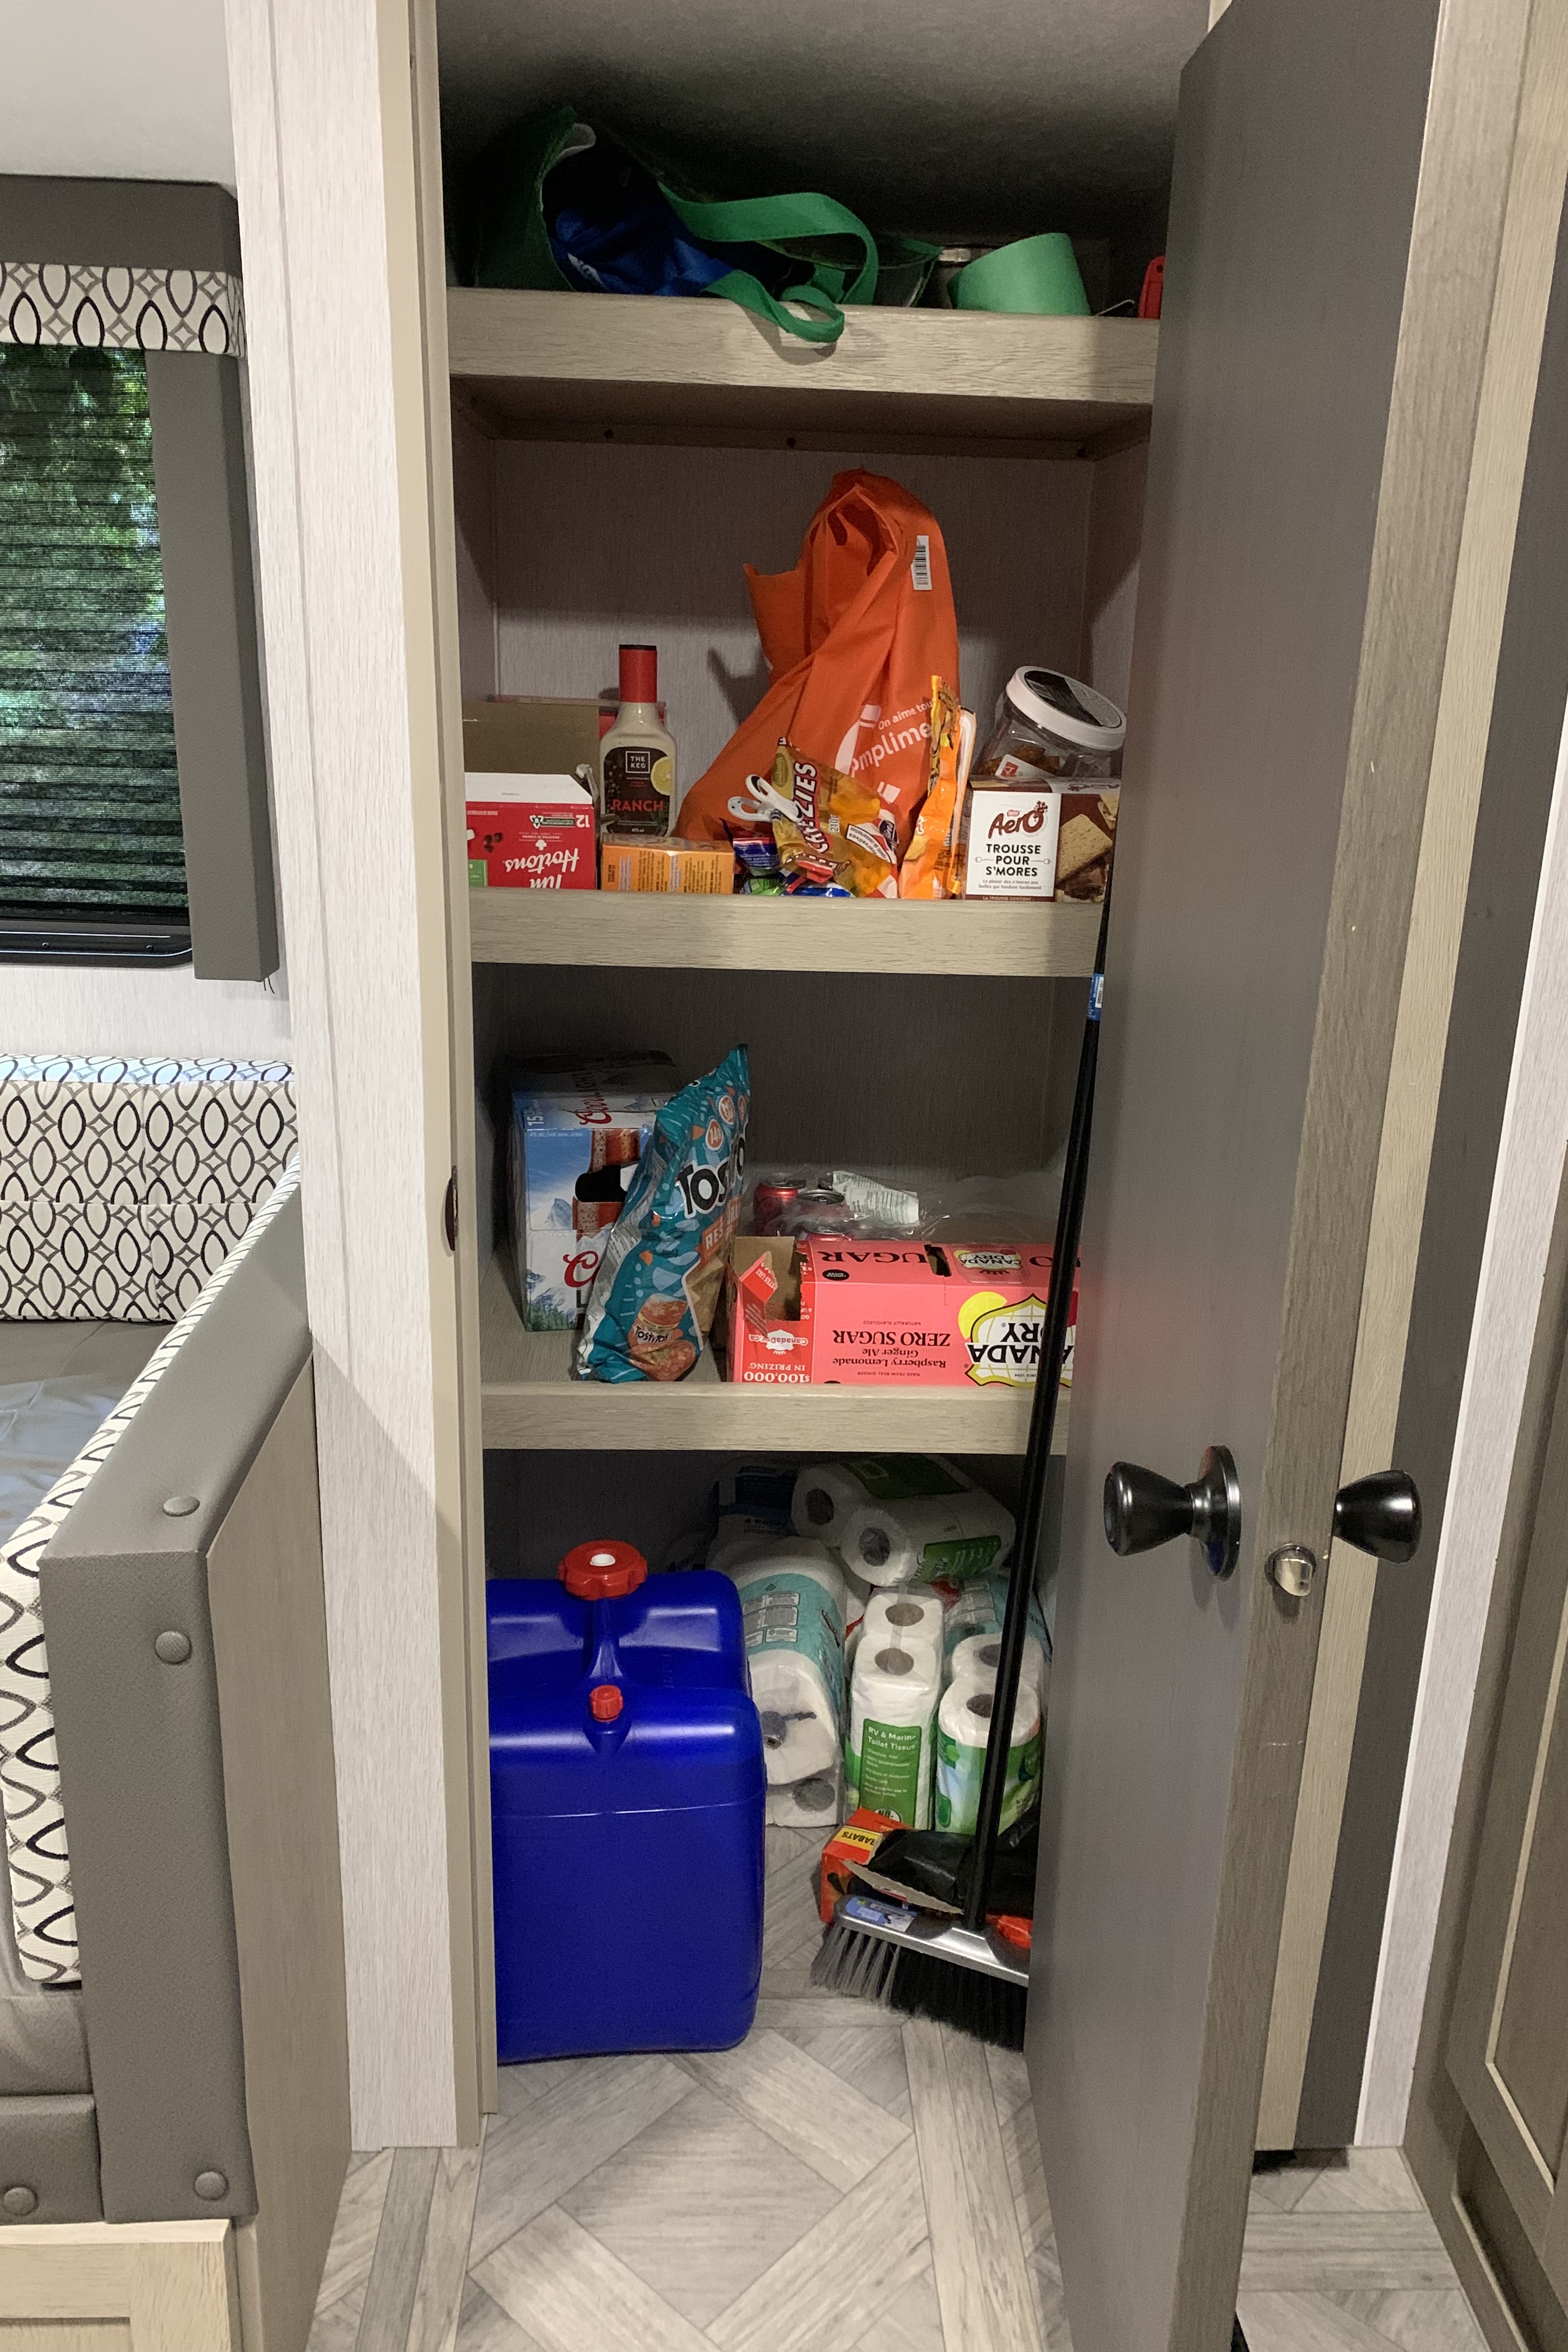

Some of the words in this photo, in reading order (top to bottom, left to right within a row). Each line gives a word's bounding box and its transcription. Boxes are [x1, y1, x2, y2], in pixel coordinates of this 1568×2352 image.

[892, 708, 916, 723] aime
[612, 799, 664, 813] RANCH
[576, 815, 590, 828] 12
[986, 844, 1041, 855] TROUSSE
[505, 848, 580, 874] Hortons
[995, 855, 1030, 865] POUR
[986, 866, 1038, 877] S'MORES
[529, 874, 562, 890] Tim
[527, 1115, 544, 1126] 15
[817, 1251, 928, 1264] UGAR
[832, 1330, 897, 1345] SUGAR
[1000, 1322, 1041, 1343] RY
[900, 1332, 951, 1346] ZERO
[881, 1348, 919, 1358] Ginger
[750, 1362, 791, 1371] PRIZING
[832, 1358, 888, 1367] Lemonade
[891, 1357, 946, 1368] Raspberry
[744, 1371, 810, 1383] $100,000
[868, 1727, 878, 1735] RV
[867, 1736, 888, 1749] Toilet
[890, 1742, 916, 1751] Tissue
